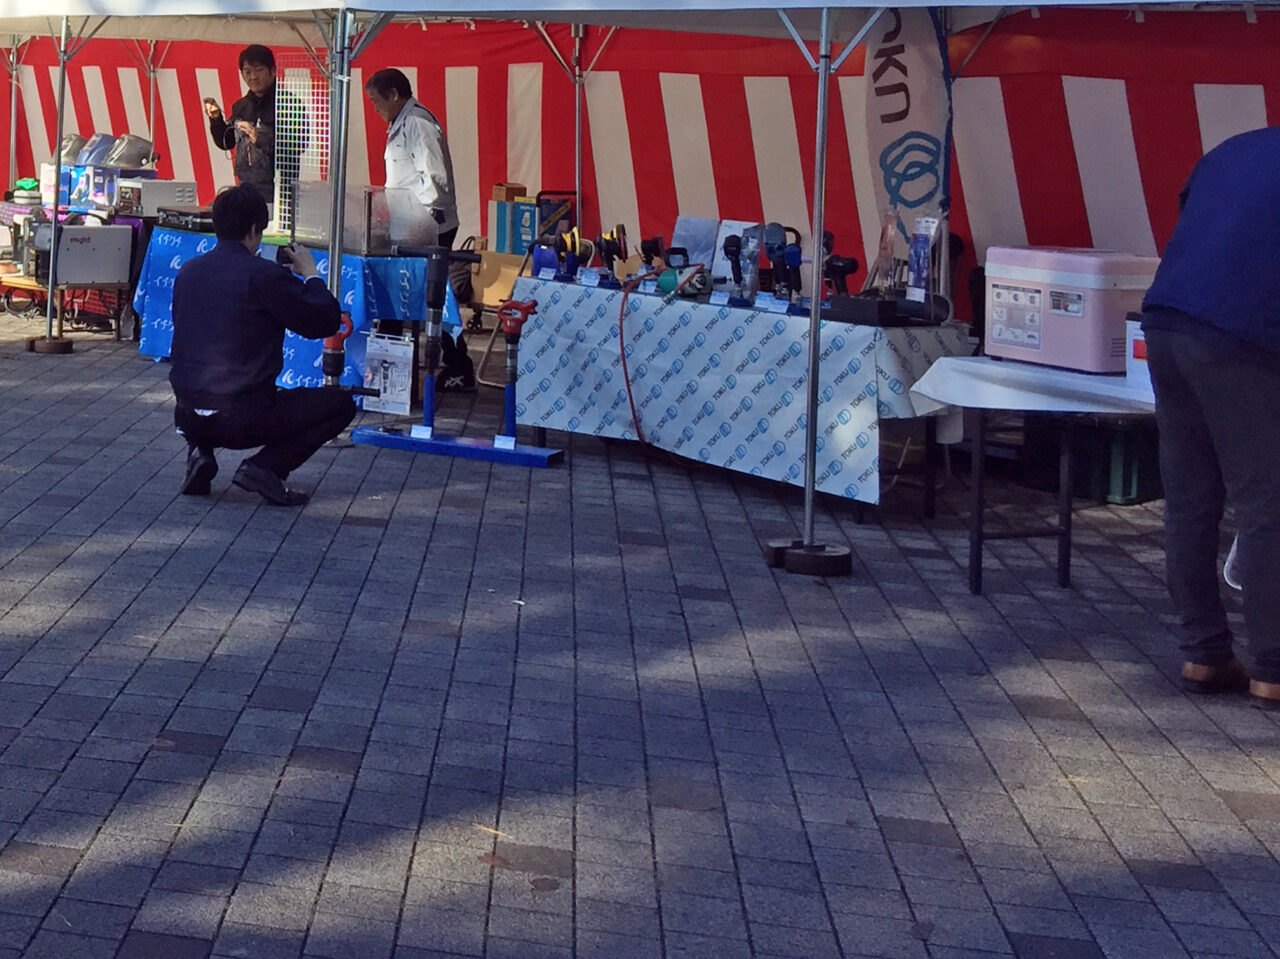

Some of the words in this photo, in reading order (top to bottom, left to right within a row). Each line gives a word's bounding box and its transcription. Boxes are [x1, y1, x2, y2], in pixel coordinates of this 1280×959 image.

[667, 321, 681, 337] TOKU
[705, 315, 720, 332] TOKU
[632, 327, 646, 343] TOKU
[759, 330, 775, 348] TOKU
[535, 343, 549, 359] TOKU
[681, 342, 696, 359] TOKU
[719, 336, 735, 353] TOKU
[645, 347, 660, 363] TOKU
[776, 351, 791, 368] TOKU
[818, 346, 834, 362] TOKU
[697, 363, 711, 379] TOKU
[735, 358, 750, 375] TOKU
[660, 368, 673, 384] TOKU
[792, 374, 807, 391] TOKU
[833, 368, 849, 386] TOKU
[526, 387, 540, 403] TOKU
[712, 384, 727, 401] TOKU
[751, 379, 766, 396] TOKU
[675, 389, 689, 405] TOKU
[849, 391, 867, 408] TOKU
[540, 406, 556, 422] TOKU
[691, 410, 705, 426] TOKU
[729, 406, 743, 422] TOKU
[767, 401, 783, 418] TOKU
[744, 427, 760, 444] TOKU
[784, 423, 799, 441] TOKU
[824, 420, 839, 436] TOKU
[706, 431, 722, 448] TOKU
[760, 450, 775, 467] TOKU
[841, 443, 857, 460] TOKU
[723, 454, 736, 469] TOKU
[814, 470, 831, 487] TOKU
[858, 466, 874, 484] TOKU
